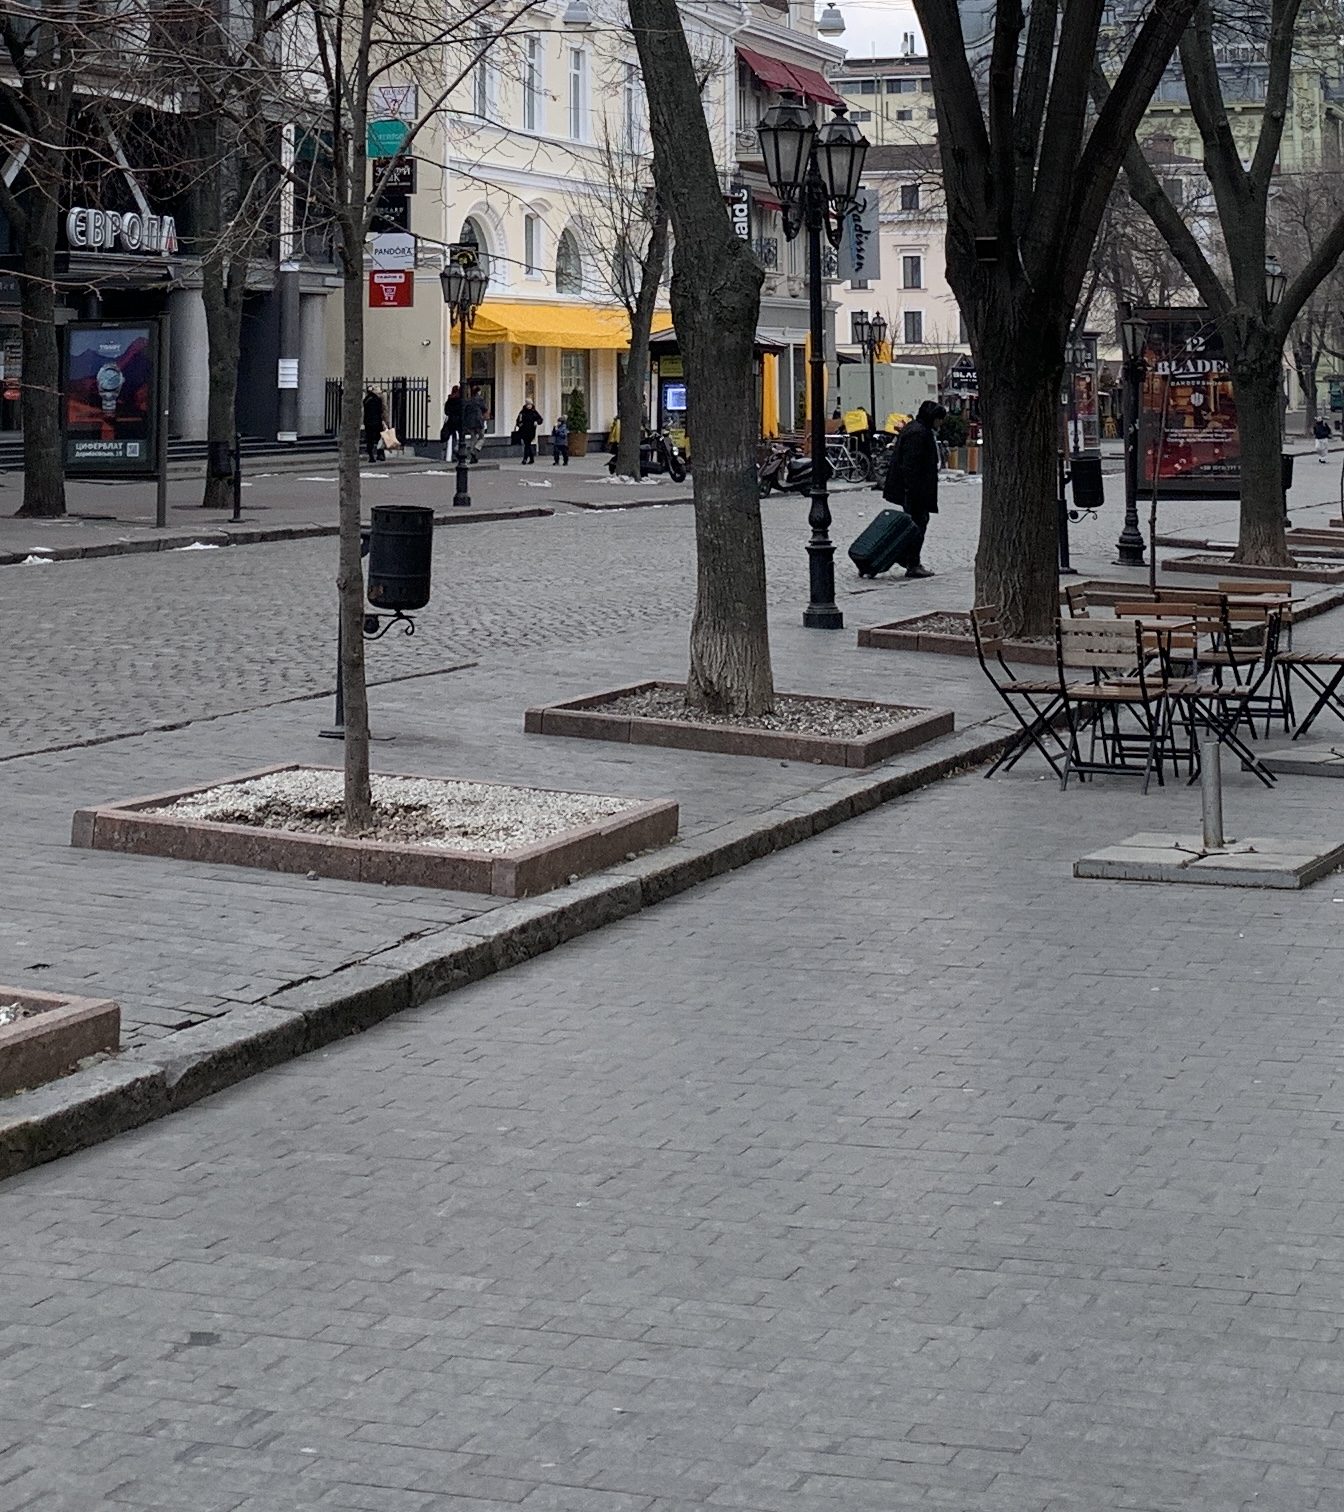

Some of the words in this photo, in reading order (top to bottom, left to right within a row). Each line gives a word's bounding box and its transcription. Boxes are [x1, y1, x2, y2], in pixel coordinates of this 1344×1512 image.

[66, 206, 179, 252] ЄВРОПА
[374, 247, 413, 256] PANDORA
[1156, 359, 1229, 375] BLADE
